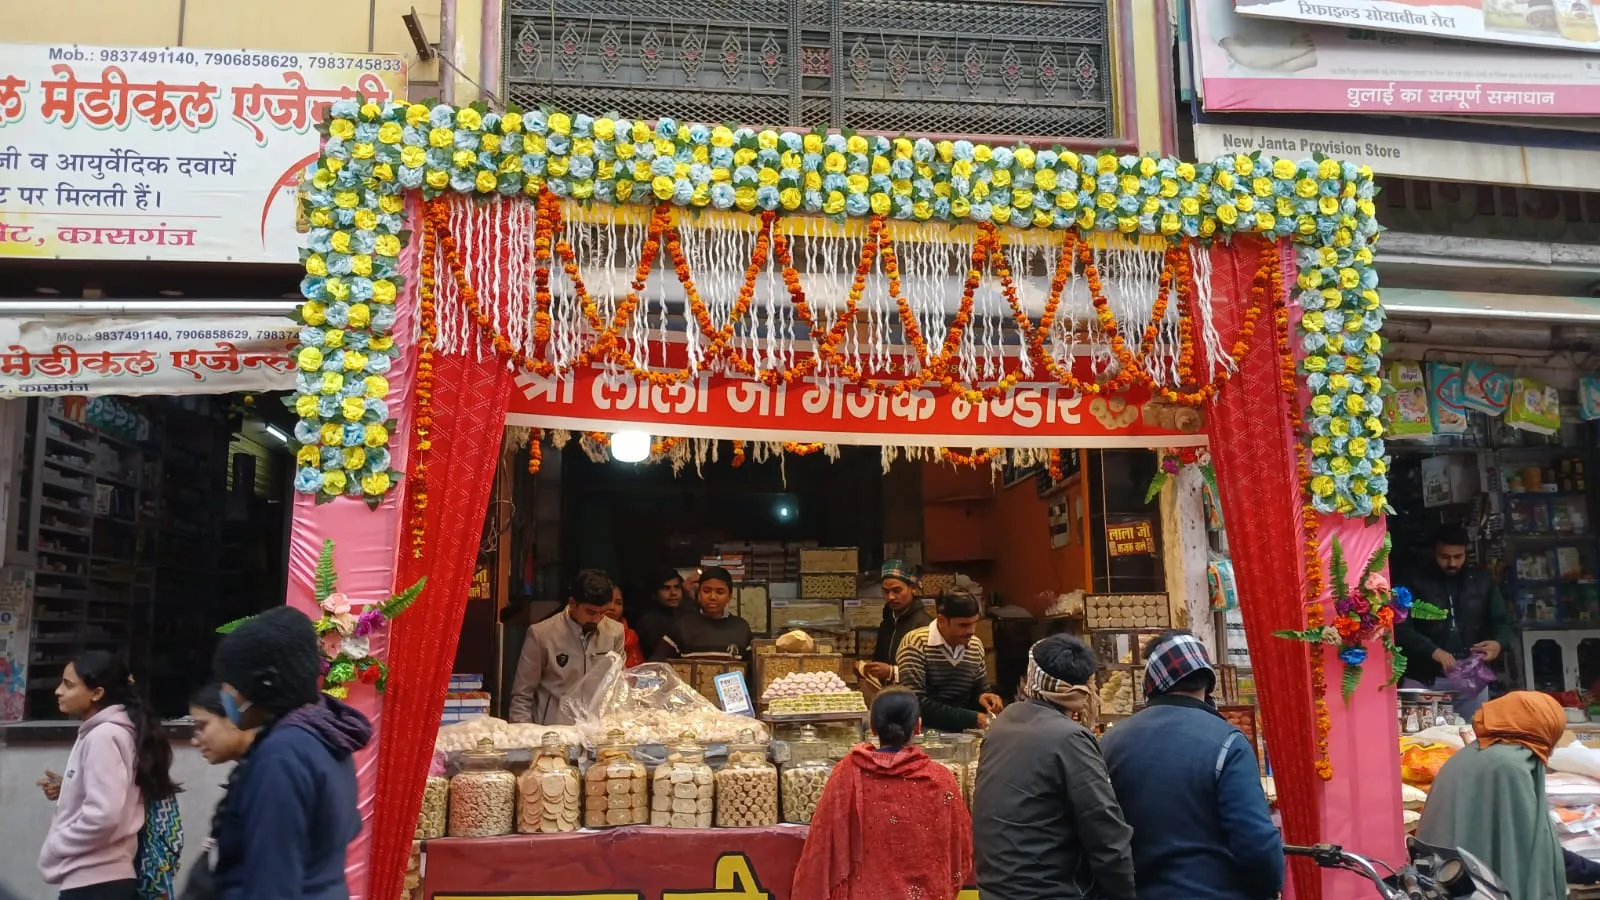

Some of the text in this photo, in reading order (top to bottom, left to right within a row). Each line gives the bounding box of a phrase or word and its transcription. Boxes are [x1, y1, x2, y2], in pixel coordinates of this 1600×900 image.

[1362, 6, 1428, 26] सोयाबीन
[1431, 12, 1456, 29] तेल
[49, 47, 401, 71] Mob.: 9837491140, 7906858629, 7983745833
[41, 63, 217, 129] मेडीकल
[1347, 82, 1555, 109] धुलाई का सम्पूर्ण समाधान
[1222, 133, 1401, 159] New Janta Provision Store
[28, 153, 49, 171] व
[56, 148, 170, 179] आयुर्वेदिक
[176, 151, 237, 177] दवायें
[17, 187, 49, 206] पर
[55, 181, 127, 207] मिलती
[57, 222, 197, 246] कासगंज
[94, 330, 172, 341] 9837491140,
[176, 330, 252, 340] 7906858629,
[0, 344, 158, 377] मेडीकल
[1108, 527, 1135, 541] लाला
